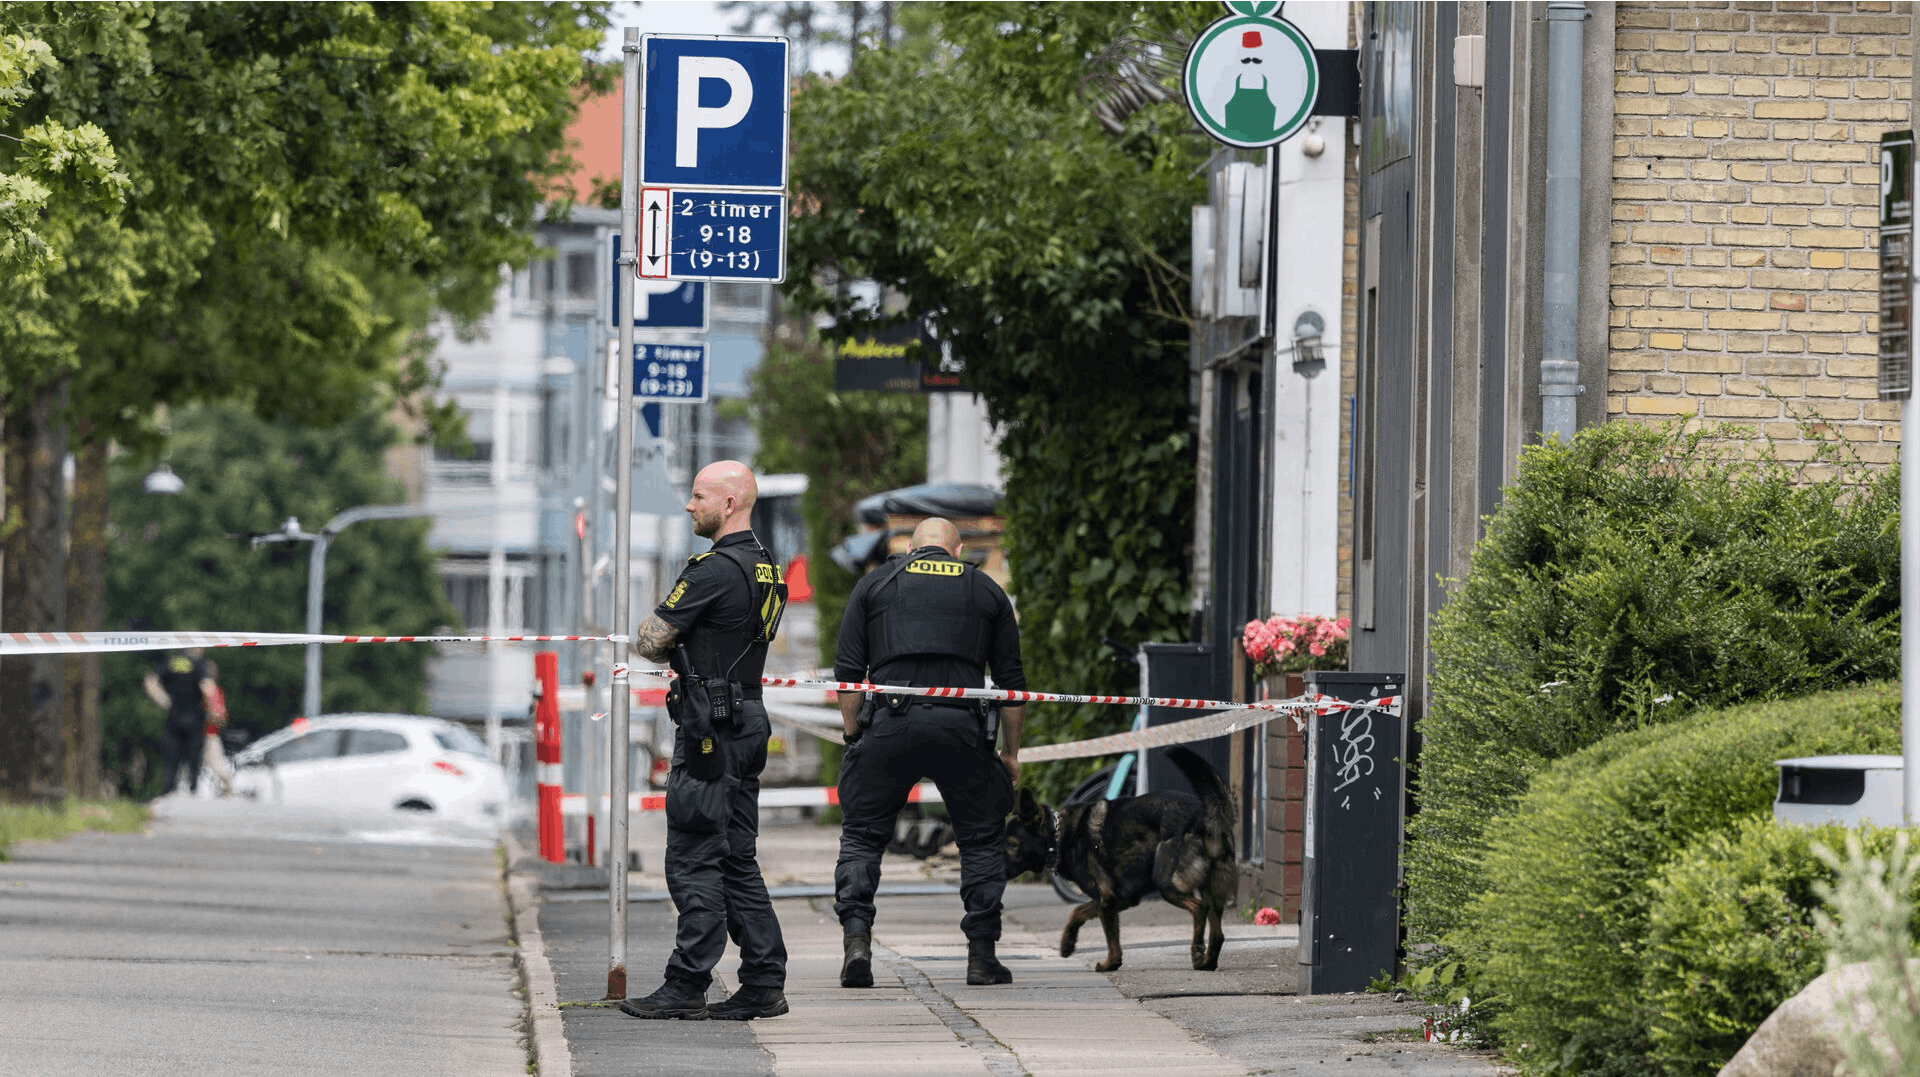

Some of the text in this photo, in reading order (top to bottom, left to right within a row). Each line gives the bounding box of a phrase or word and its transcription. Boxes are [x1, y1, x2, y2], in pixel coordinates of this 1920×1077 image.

[676, 56, 753, 167] P
[681, 199, 772, 218] 2 timer
[700, 225, 751, 244] 9-18
[690, 249, 760, 271] (9-13)
[635, 345, 647, 360] 2
[907, 562, 962, 573] POLITI
